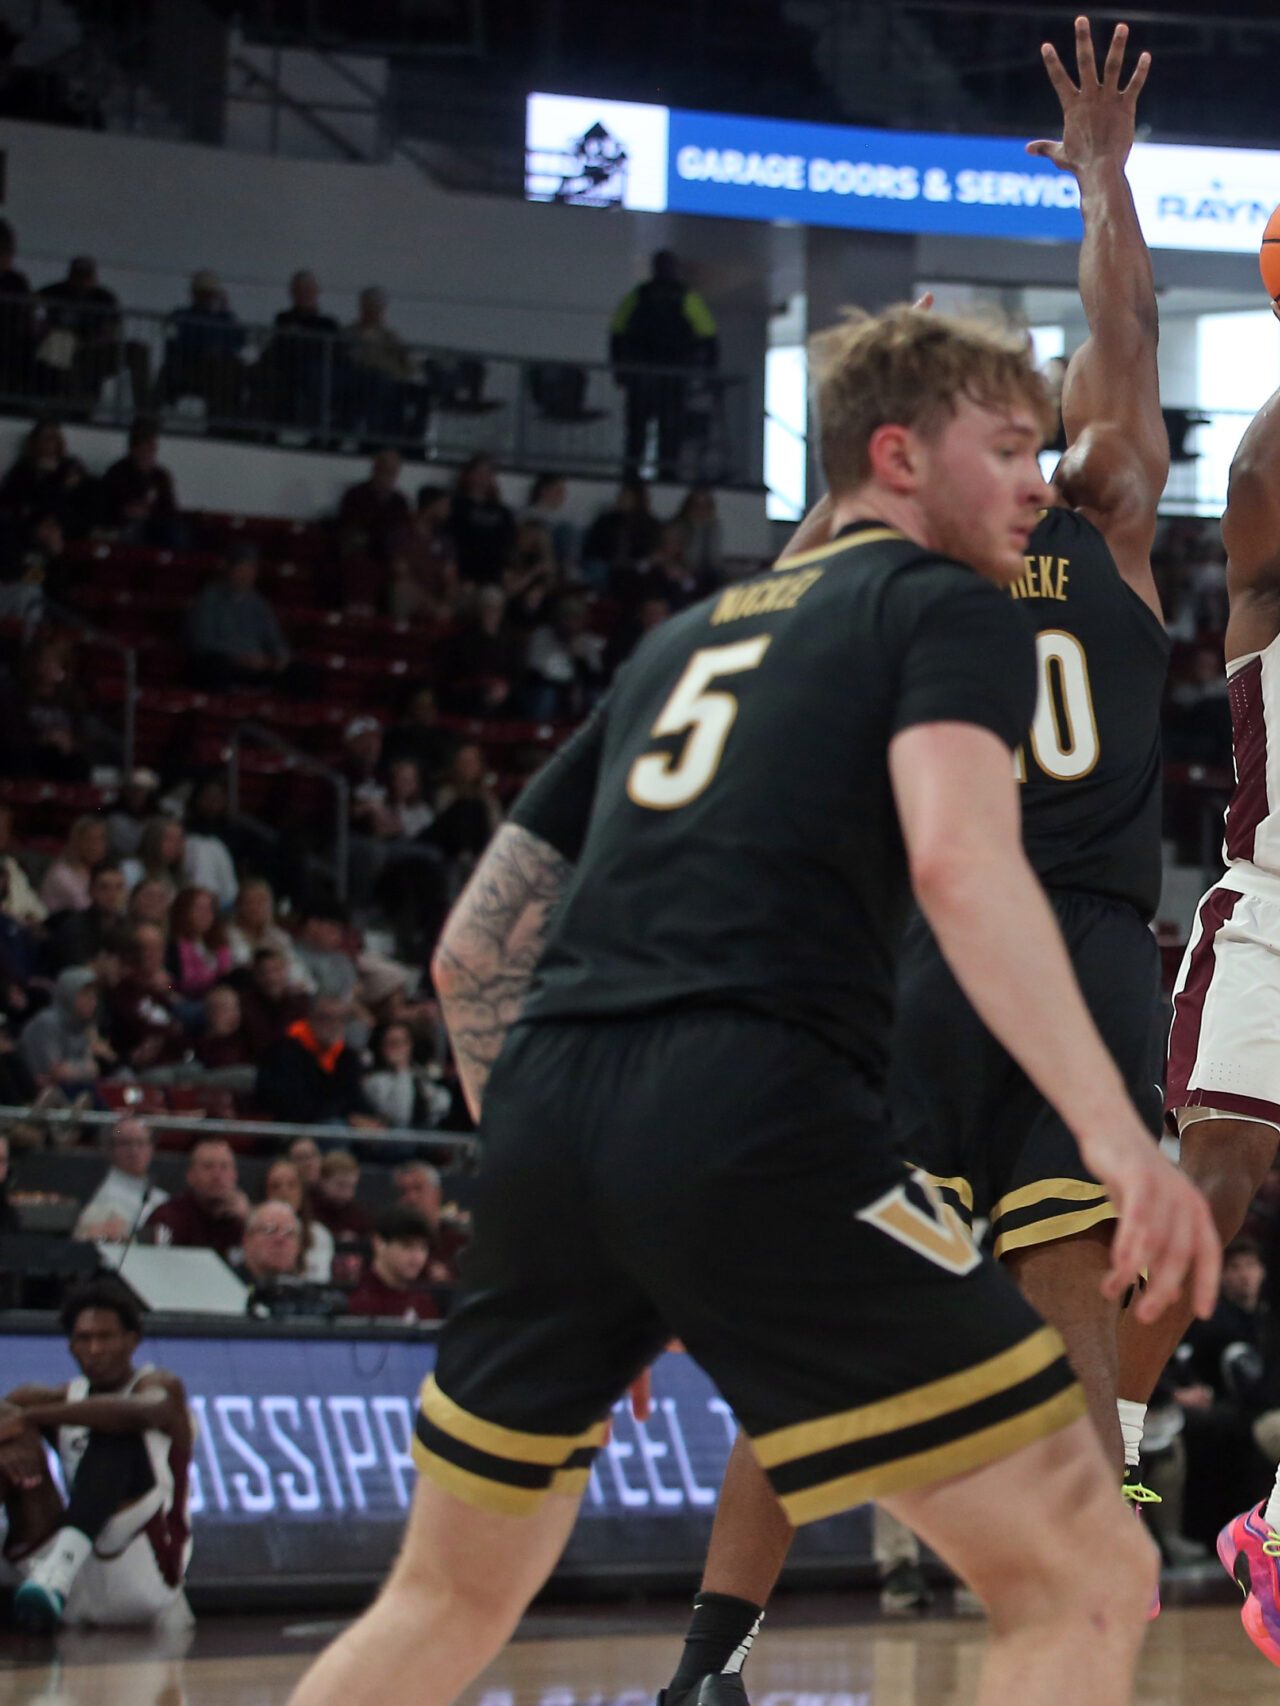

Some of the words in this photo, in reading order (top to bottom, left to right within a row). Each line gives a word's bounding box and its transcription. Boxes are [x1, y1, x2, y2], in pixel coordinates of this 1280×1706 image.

[675, 144, 806, 191] GARAGE
[807, 158, 920, 201] DOORS
[922, 167, 953, 203] &
[956, 169, 1082, 209] SERVIC
[627, 633, 772, 812] 5
[1013, 629, 1100, 783] 0
[187, 1395, 420, 1512] ISSIPP
[590, 1397, 717, 1507] EEL
